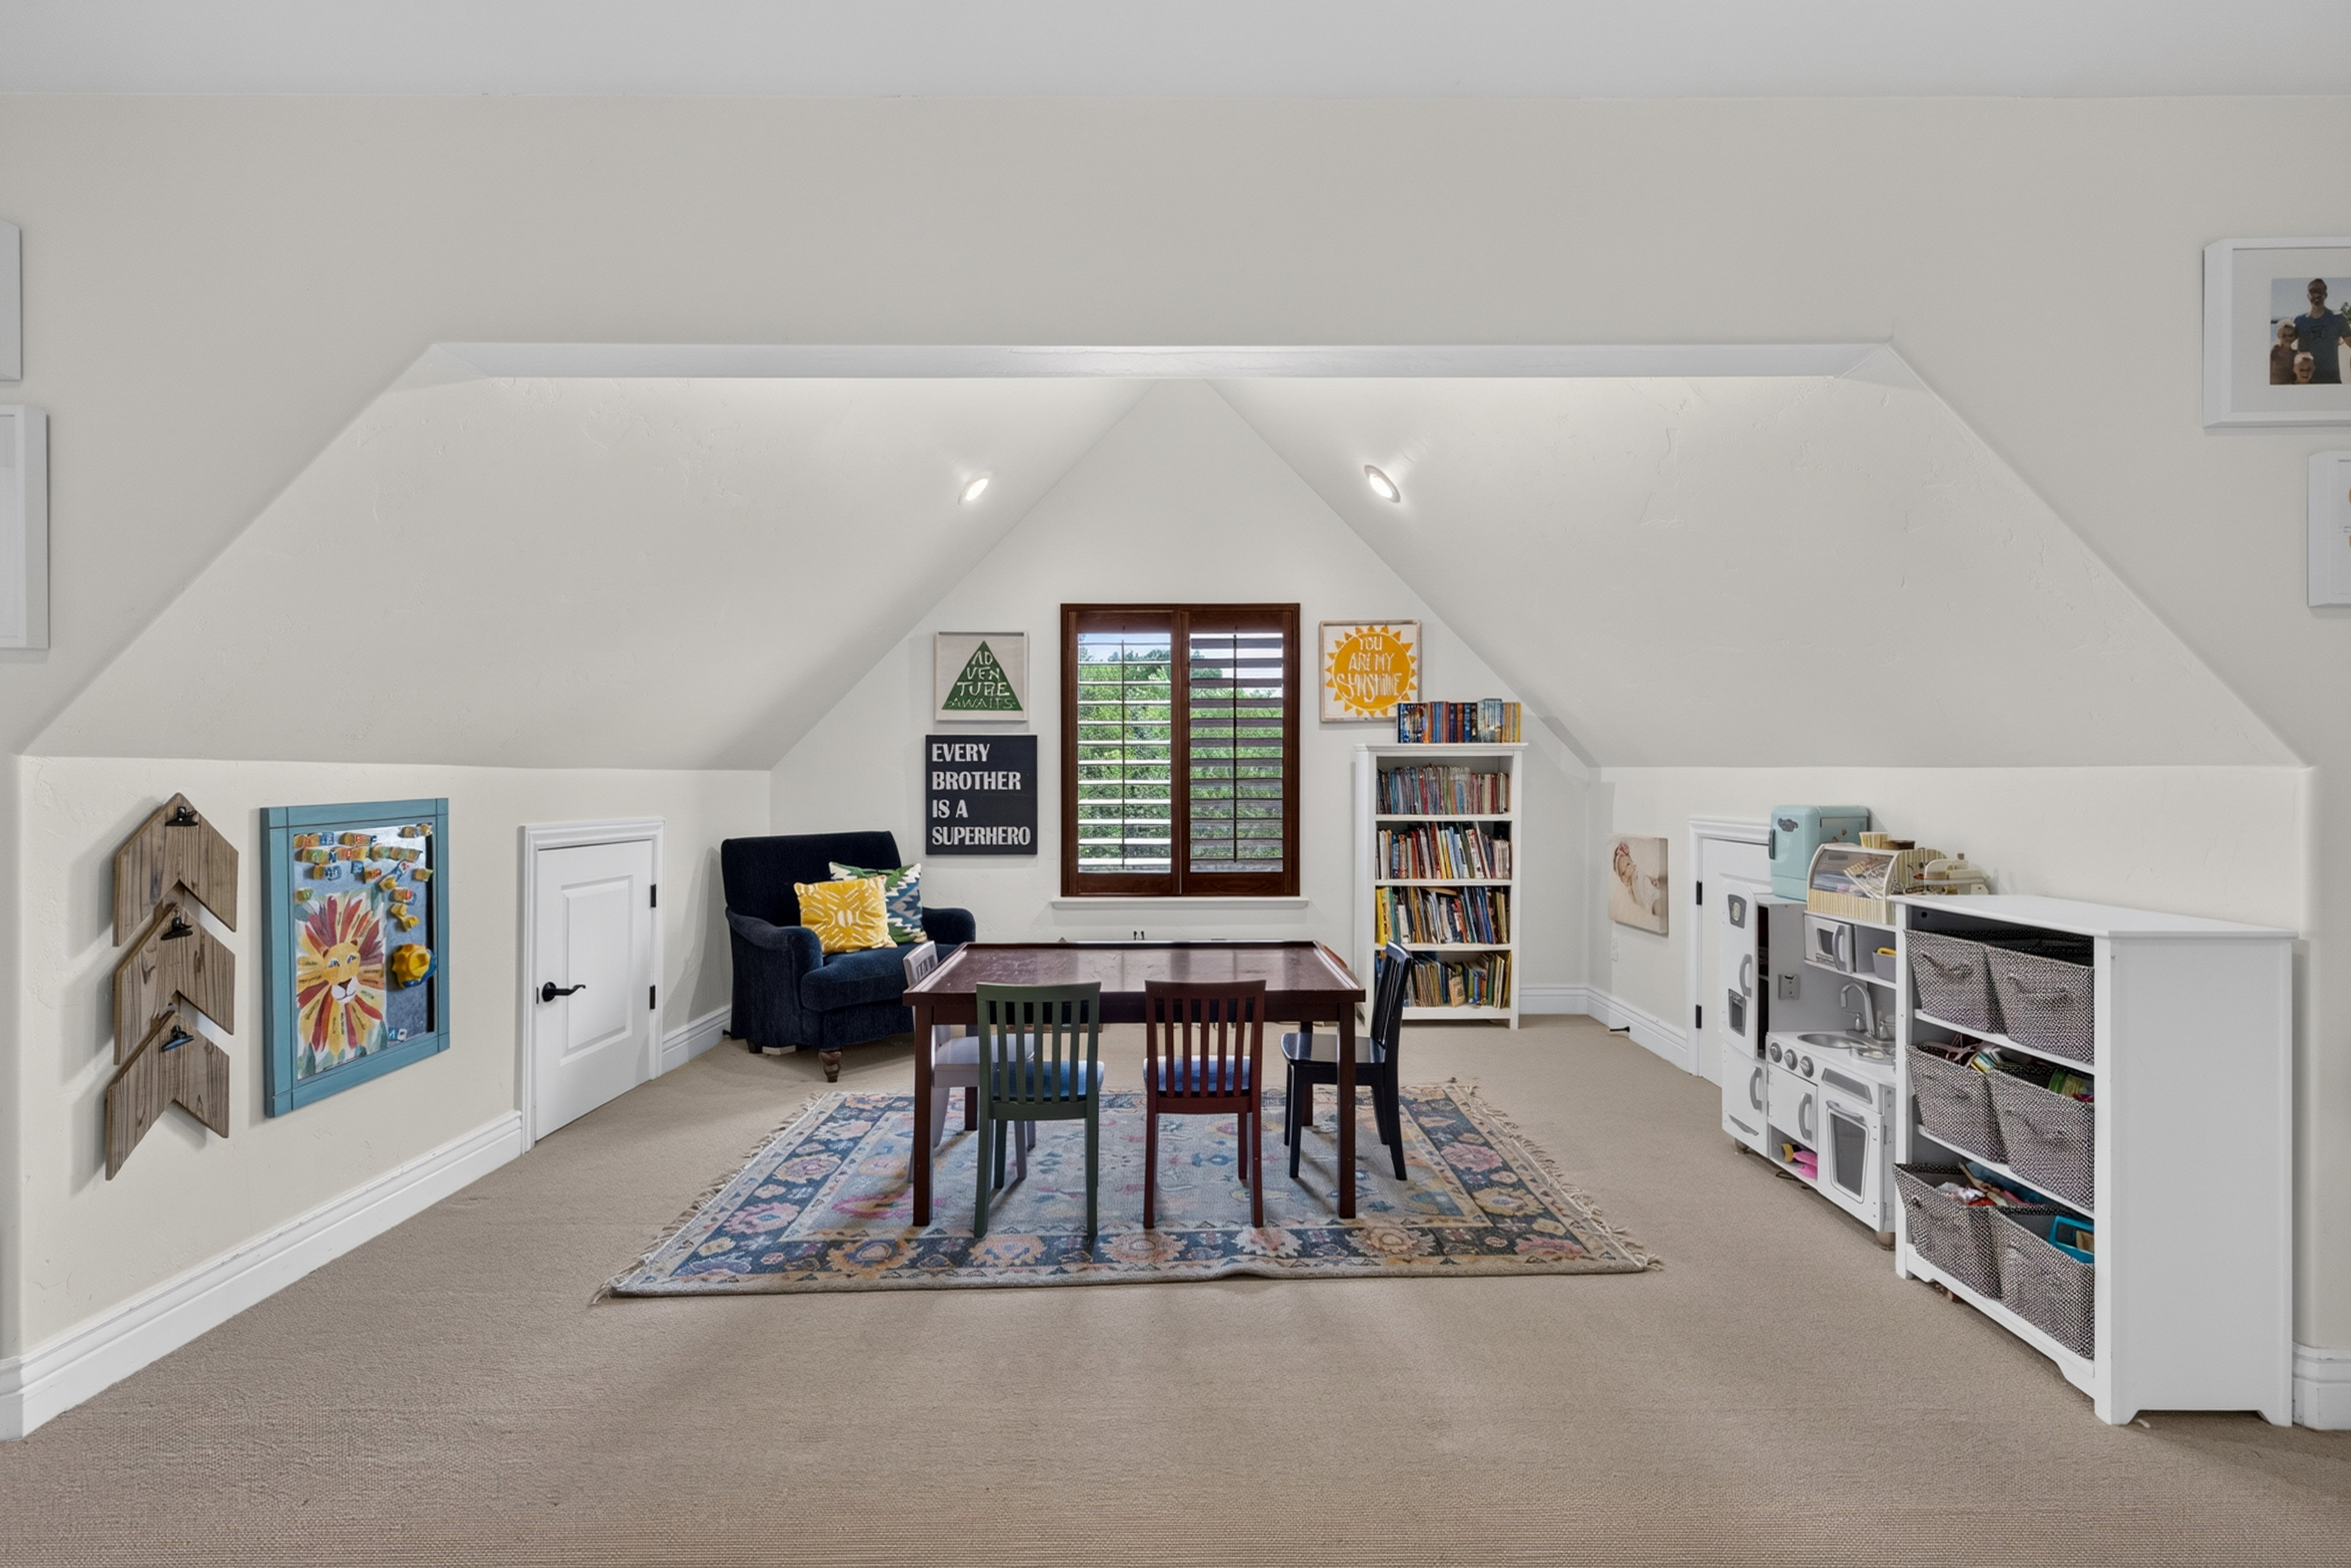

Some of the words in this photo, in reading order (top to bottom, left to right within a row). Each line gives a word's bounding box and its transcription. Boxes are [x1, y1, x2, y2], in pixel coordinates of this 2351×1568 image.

[1358, 636, 1382, 651] YOU
[971, 651, 993, 665] AD
[1349, 653, 1370, 671] ARE
[1374, 652, 1395, 671] MY
[966, 666, 1000, 681] VEN
[957, 681, 1010, 696] TURE
[1337, 672, 1402, 703] SUNSHINE
[953, 697, 1013, 709] AWAITS
[932, 744, 990, 762] EVERY
[932, 771, 1021, 791] BROTHER
[932, 799, 950, 819] IS
[956, 800, 968, 818] A
[932, 826, 1031, 845] SUPERHERO
